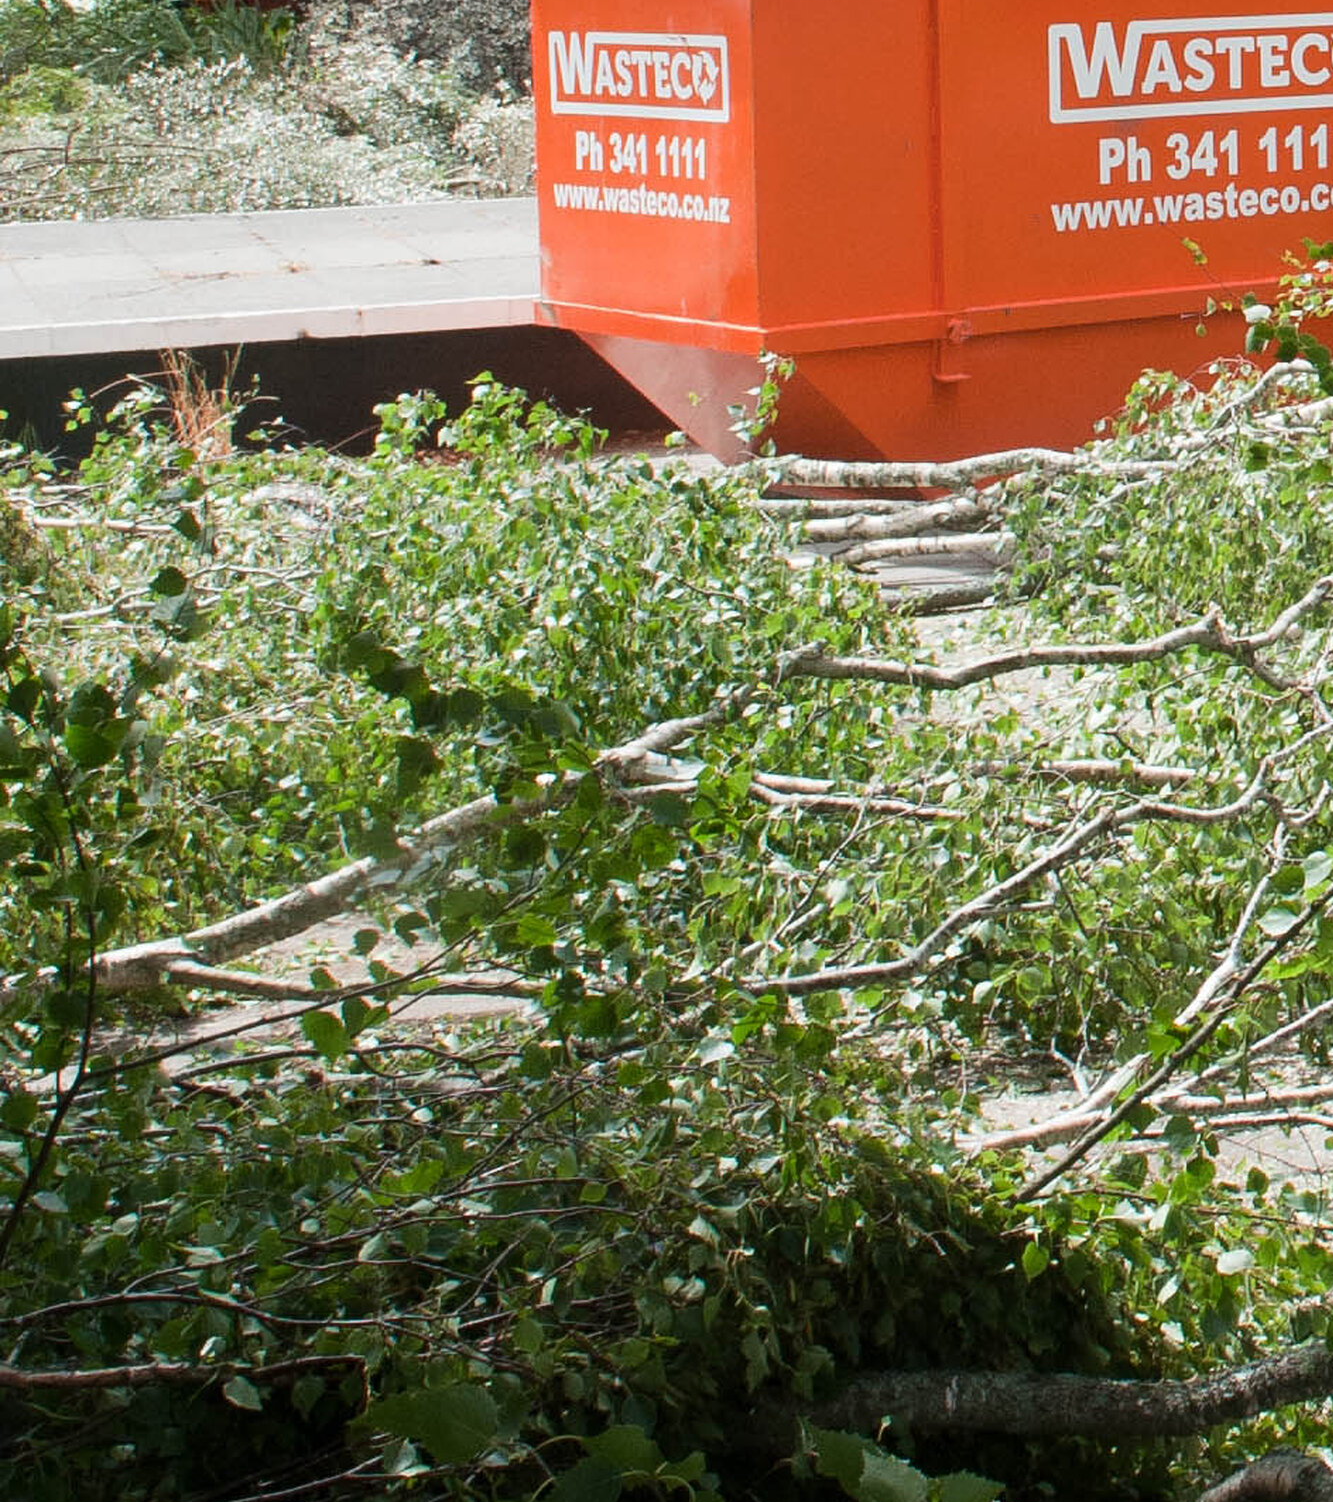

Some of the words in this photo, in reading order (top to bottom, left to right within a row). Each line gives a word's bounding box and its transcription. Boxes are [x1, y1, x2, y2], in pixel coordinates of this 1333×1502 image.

[575, 131, 603, 171] Ph
[609, 132, 647, 175] 341
[655, 135, 706, 180] 1111
[1099, 136, 1151, 184] Ph
[1166, 129, 1239, 179] 341
[553, 183, 731, 223] www.wasteco.co.nz
